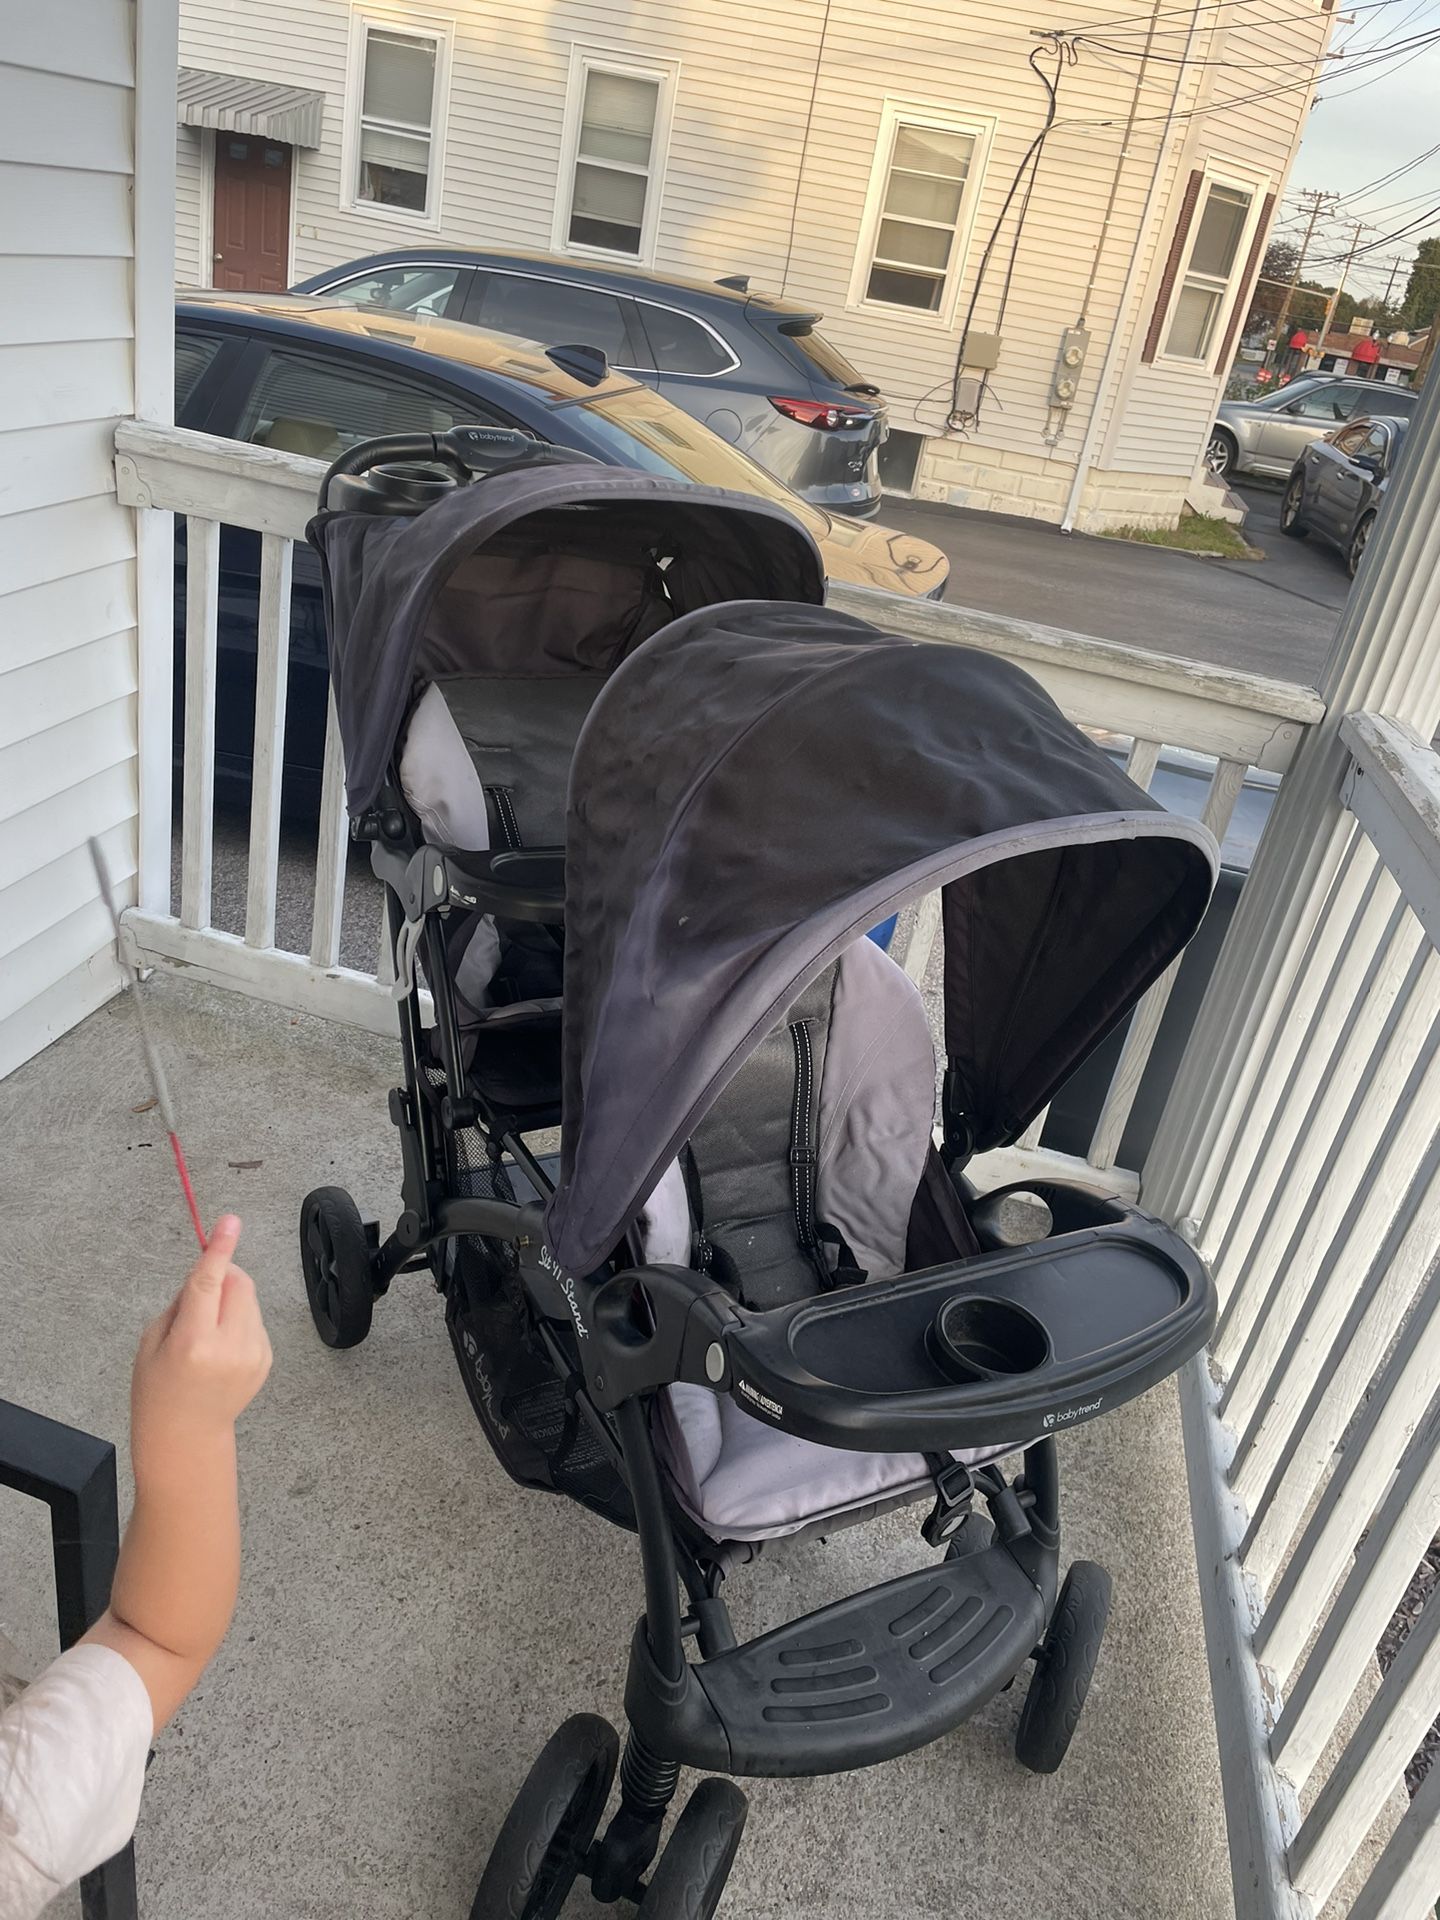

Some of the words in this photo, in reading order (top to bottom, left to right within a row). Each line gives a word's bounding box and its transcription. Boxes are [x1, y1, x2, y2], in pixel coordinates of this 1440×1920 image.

[479, 432, 515, 442] babytrend
[560, 1278, 588, 1338] Stand
[1056, 1397, 1103, 1422] babytrend
